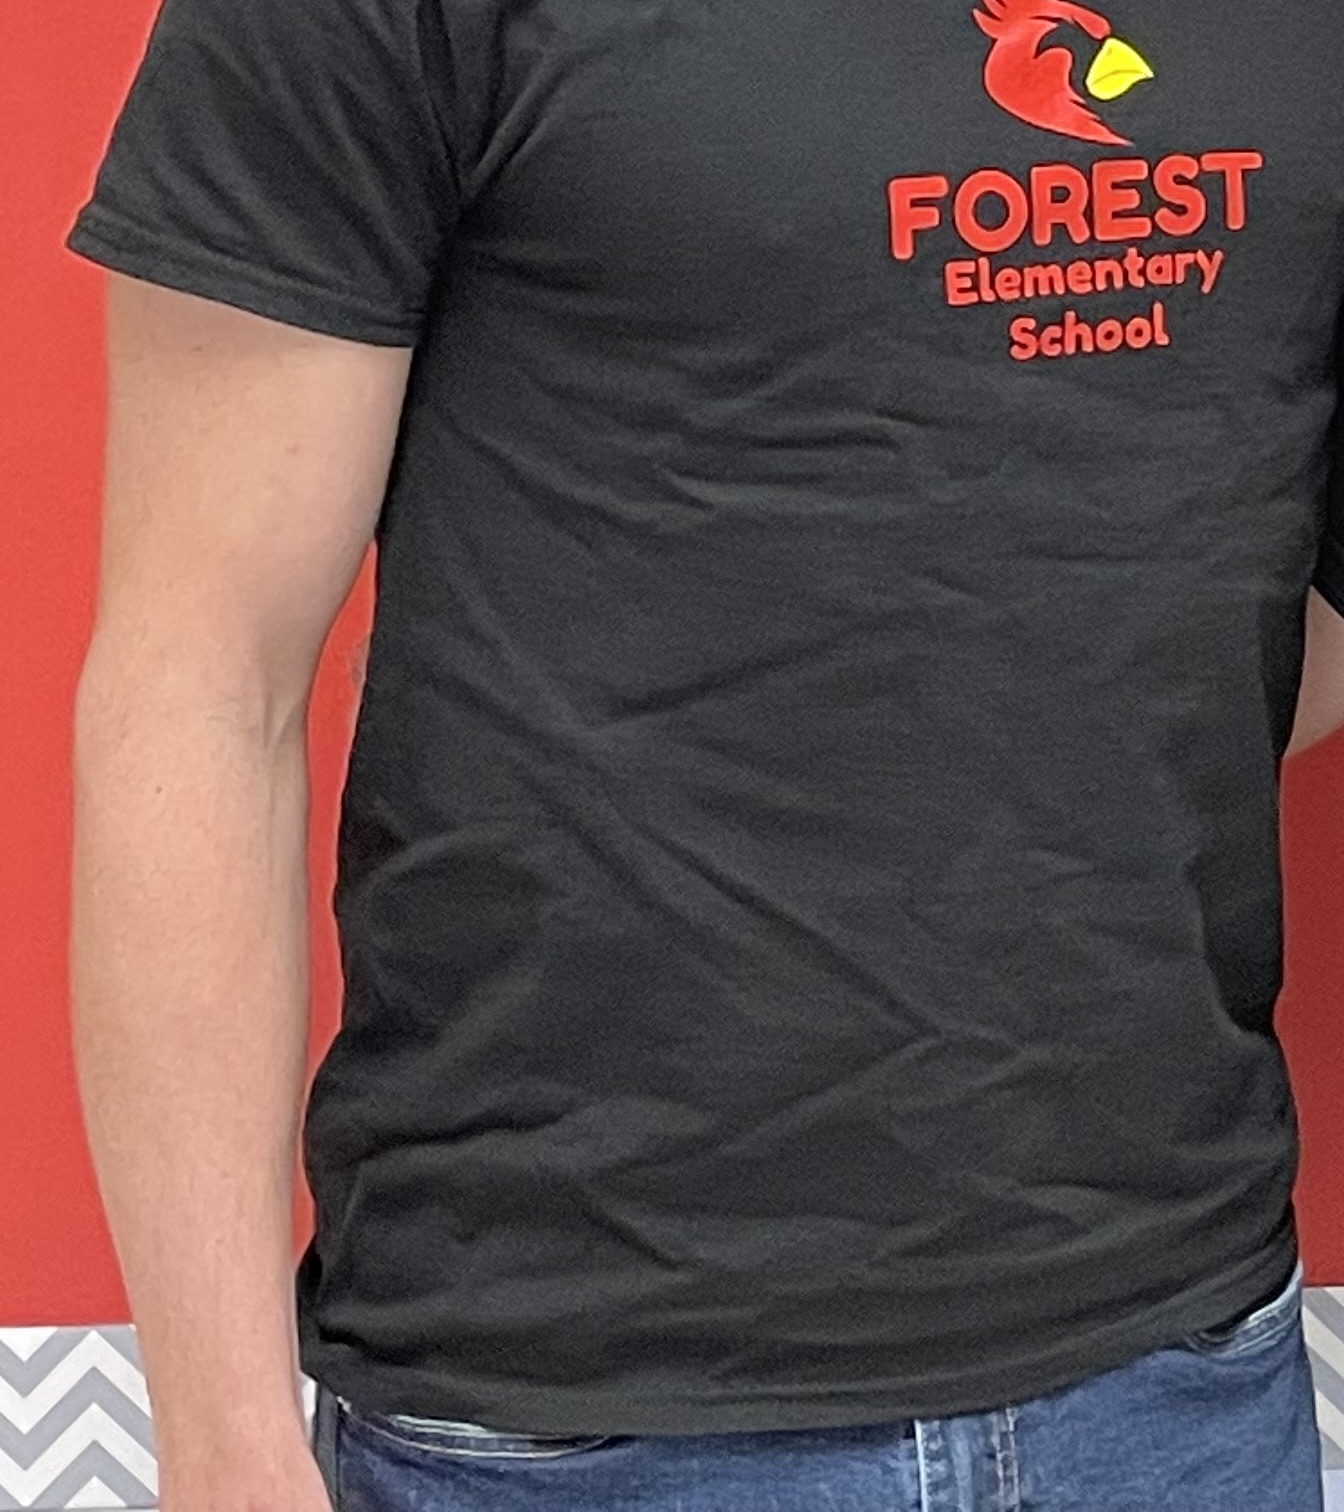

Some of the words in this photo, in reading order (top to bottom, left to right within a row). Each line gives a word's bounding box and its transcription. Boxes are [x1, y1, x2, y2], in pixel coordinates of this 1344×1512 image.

[887, 151, 1263, 261] FOREST
[944, 247, 1223, 306] Elementary
[1008, 303, 1169, 361] School
